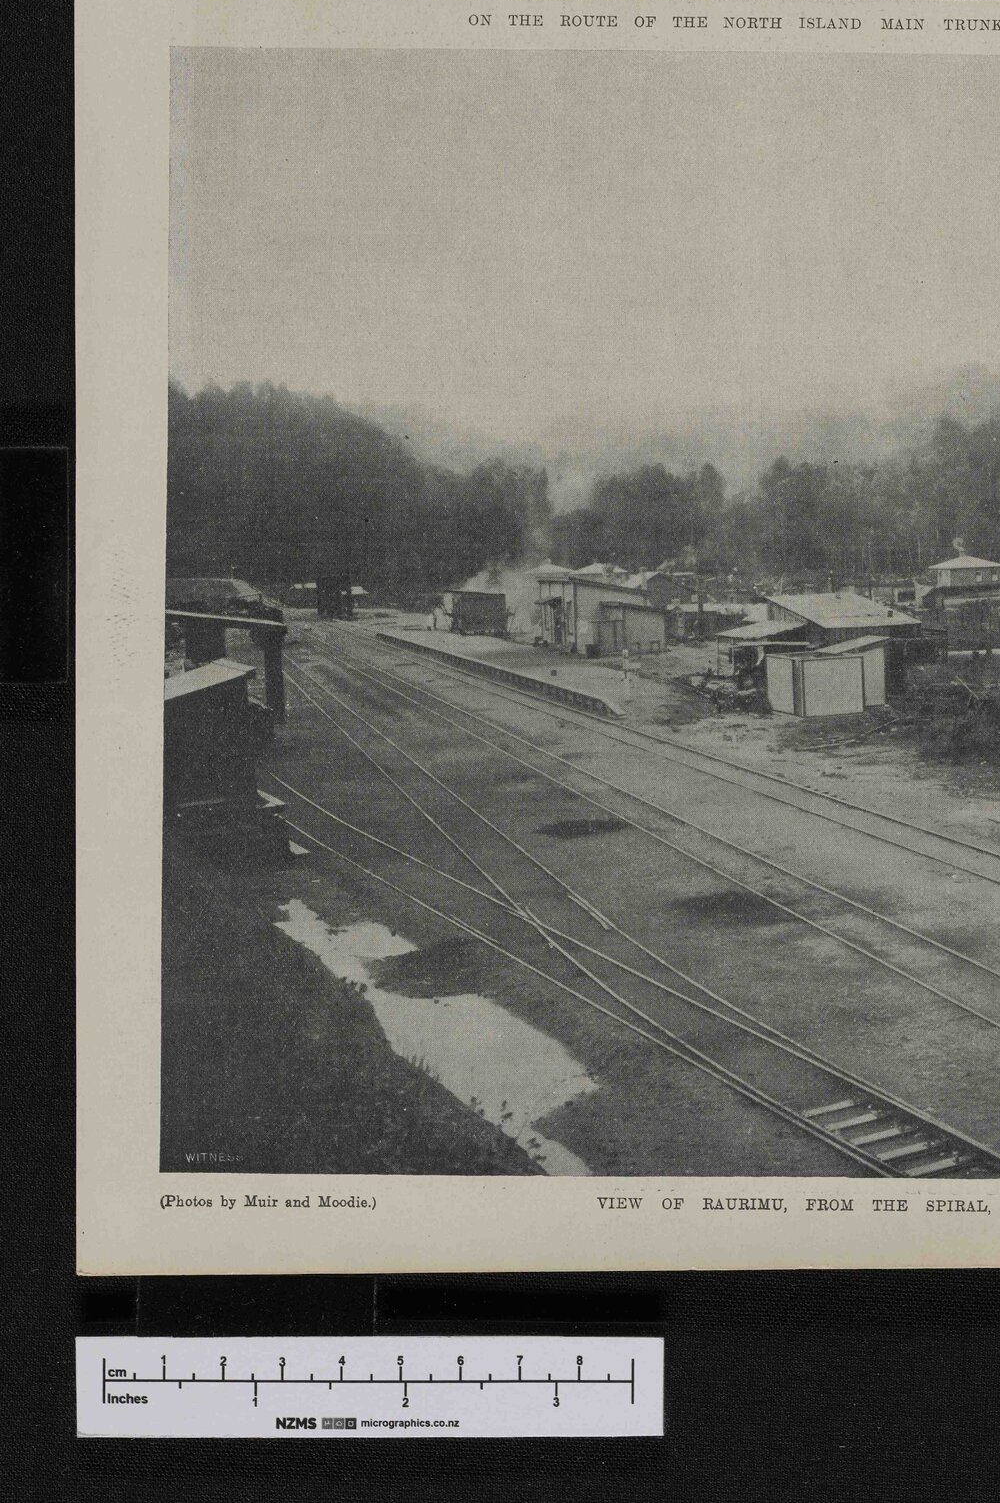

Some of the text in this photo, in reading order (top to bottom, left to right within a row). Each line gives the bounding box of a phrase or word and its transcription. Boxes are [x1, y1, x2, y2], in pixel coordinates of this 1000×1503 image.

[469, 14, 492, 26] ON
[509, 15, 543, 26] THE
[560, 15, 617, 27] ROUTE
[635, 16, 656, 27] OF
[673, 17, 707, 28] THE
[724, 17, 782, 29] NORTH
[800, 18, 861, 29] ISLAND
[881, 19, 924, 30] MAIN
[160, 1195, 377, 1210] (Photos by Muir and Moodie.)
[597, 1197, 643, 1209] VIEW
[662, 1198, 684, 1209] OF
[703, 1198, 787, 1213] RAURIMU,
[806, 1199, 853, 1211] FROM
[872, 1200, 908, 1211] THE
[926, 1200, 991, 1215] SPIRAL,
[160, 1355, 584, 1366] 1 2 3 4 5 6 7 8
[107, 1368, 127, 1378] cm
[107, 1392, 149, 1405] Inches
[402, 1397, 409, 1408] 2
[552, 1397, 560, 1408] 3
[276, 1417, 460, 1430] NZMS micrographics.co.nz
